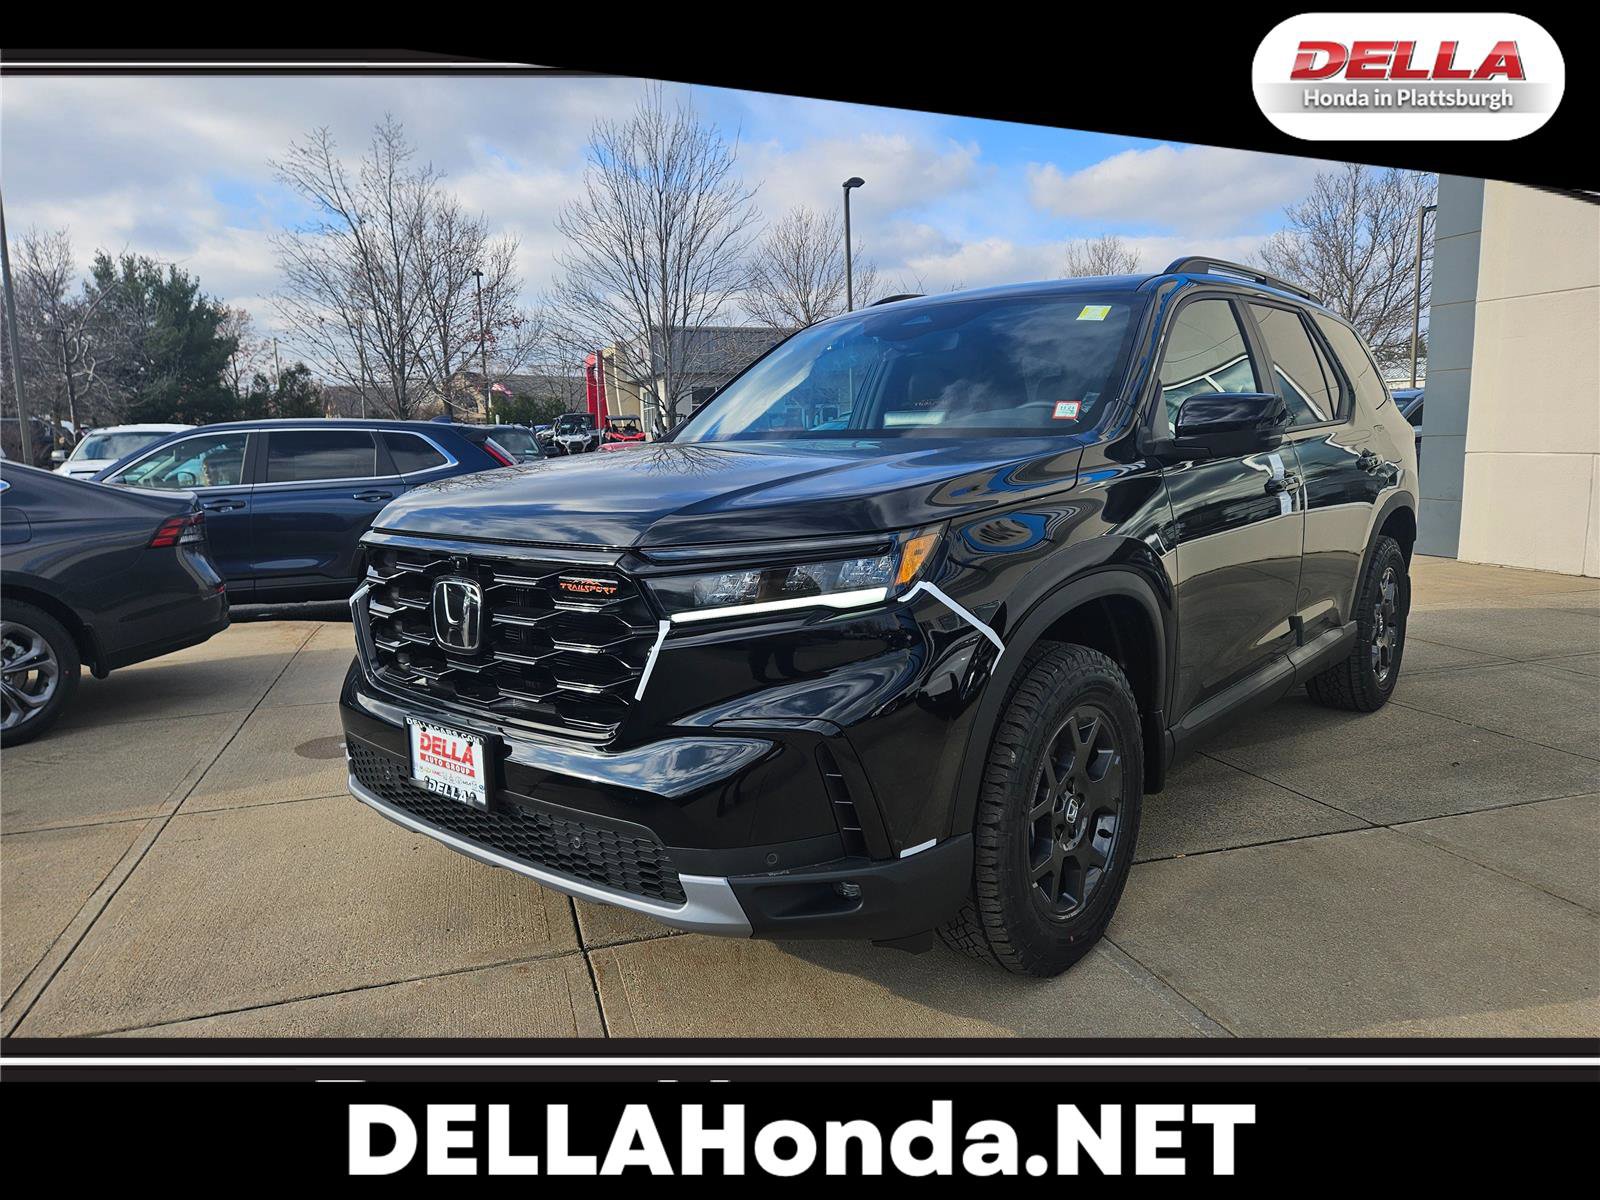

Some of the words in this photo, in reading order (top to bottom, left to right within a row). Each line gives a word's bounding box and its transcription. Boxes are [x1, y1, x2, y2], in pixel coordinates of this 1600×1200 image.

[560, 582, 617, 595] TRAILSPORT
[419, 732, 475, 767] DELLA
[424, 754, 443, 766] AUTO
[445, 760, 471, 775] GROUP
[427, 778, 468, 803] DELLA
